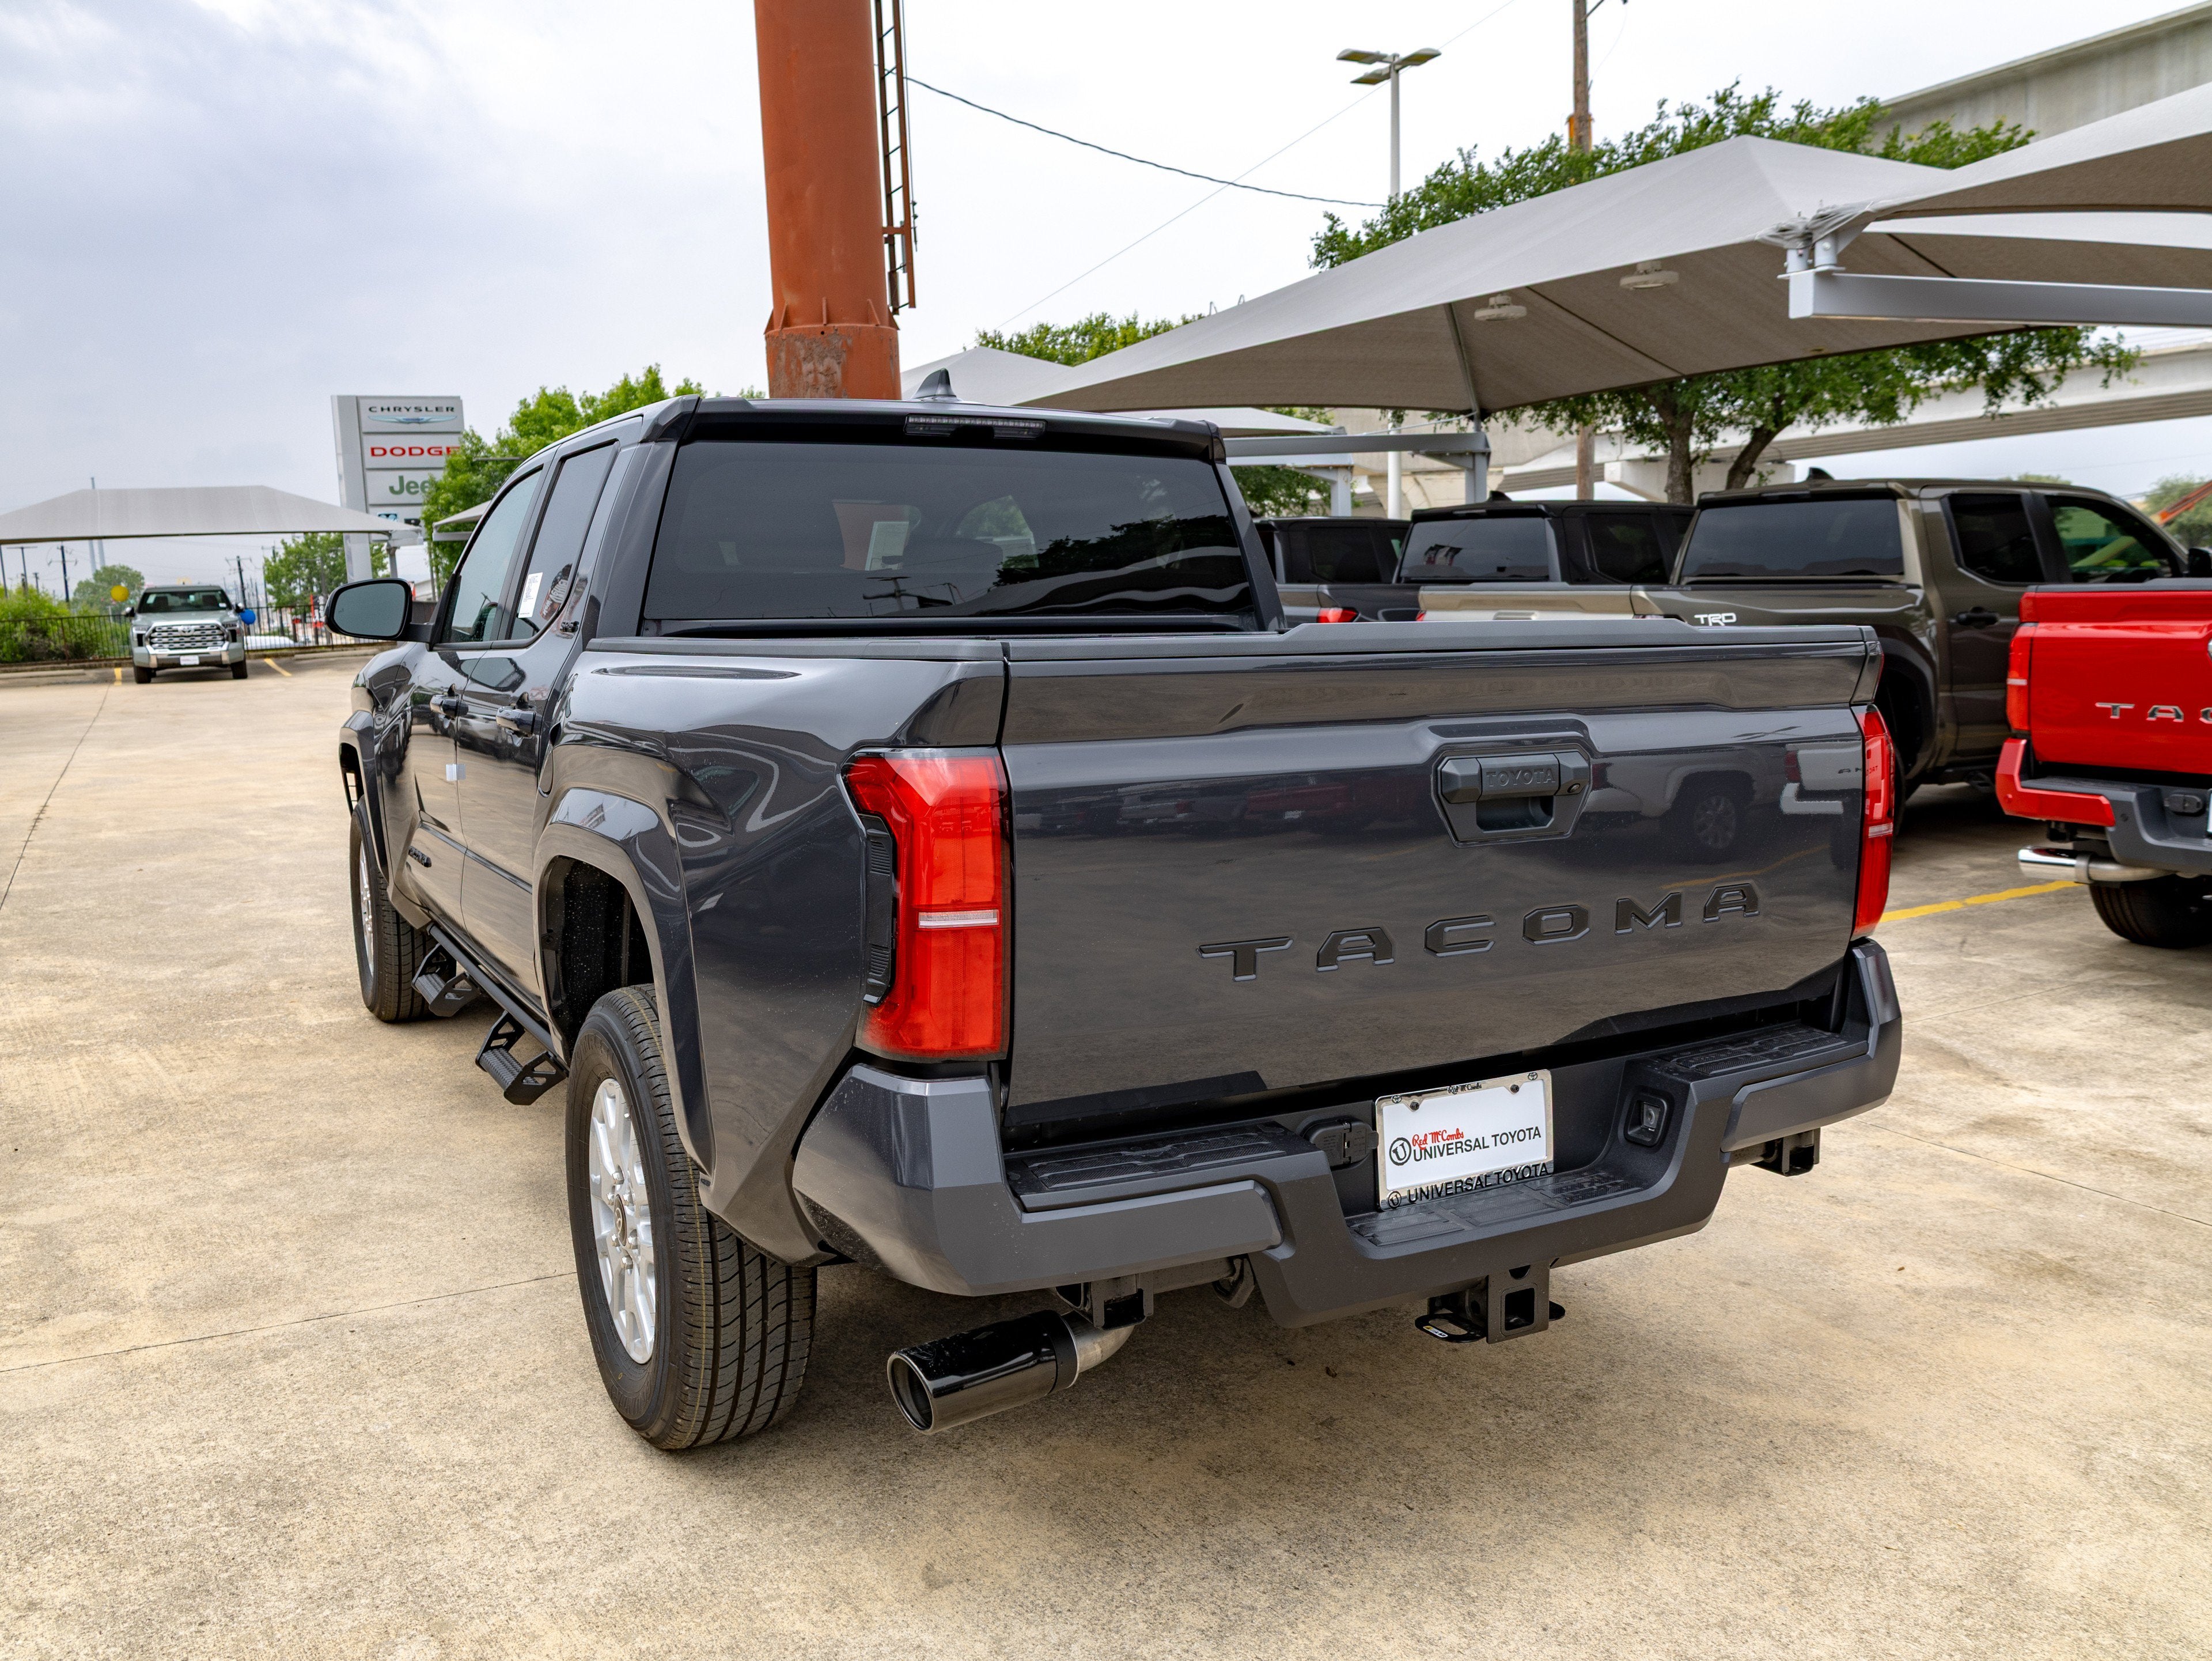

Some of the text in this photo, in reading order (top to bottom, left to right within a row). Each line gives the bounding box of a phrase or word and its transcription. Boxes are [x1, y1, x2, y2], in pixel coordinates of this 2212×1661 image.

[389, 475, 431, 495] Jee
[1694, 612, 1737, 626] TRD
[1486, 768, 1556, 787] TOYOTA
[1196, 883, 1759, 981] TACOMA
[1412, 1127, 1464, 1150] Red McCombs
[1413, 1136, 1489, 1162] UNIVERSAL
[1491, 1126, 1541, 1147] TOYOTA
[1407, 1173, 1492, 1203] UNIVERSAL
[1493, 1161, 1550, 1185] TOYOTA
